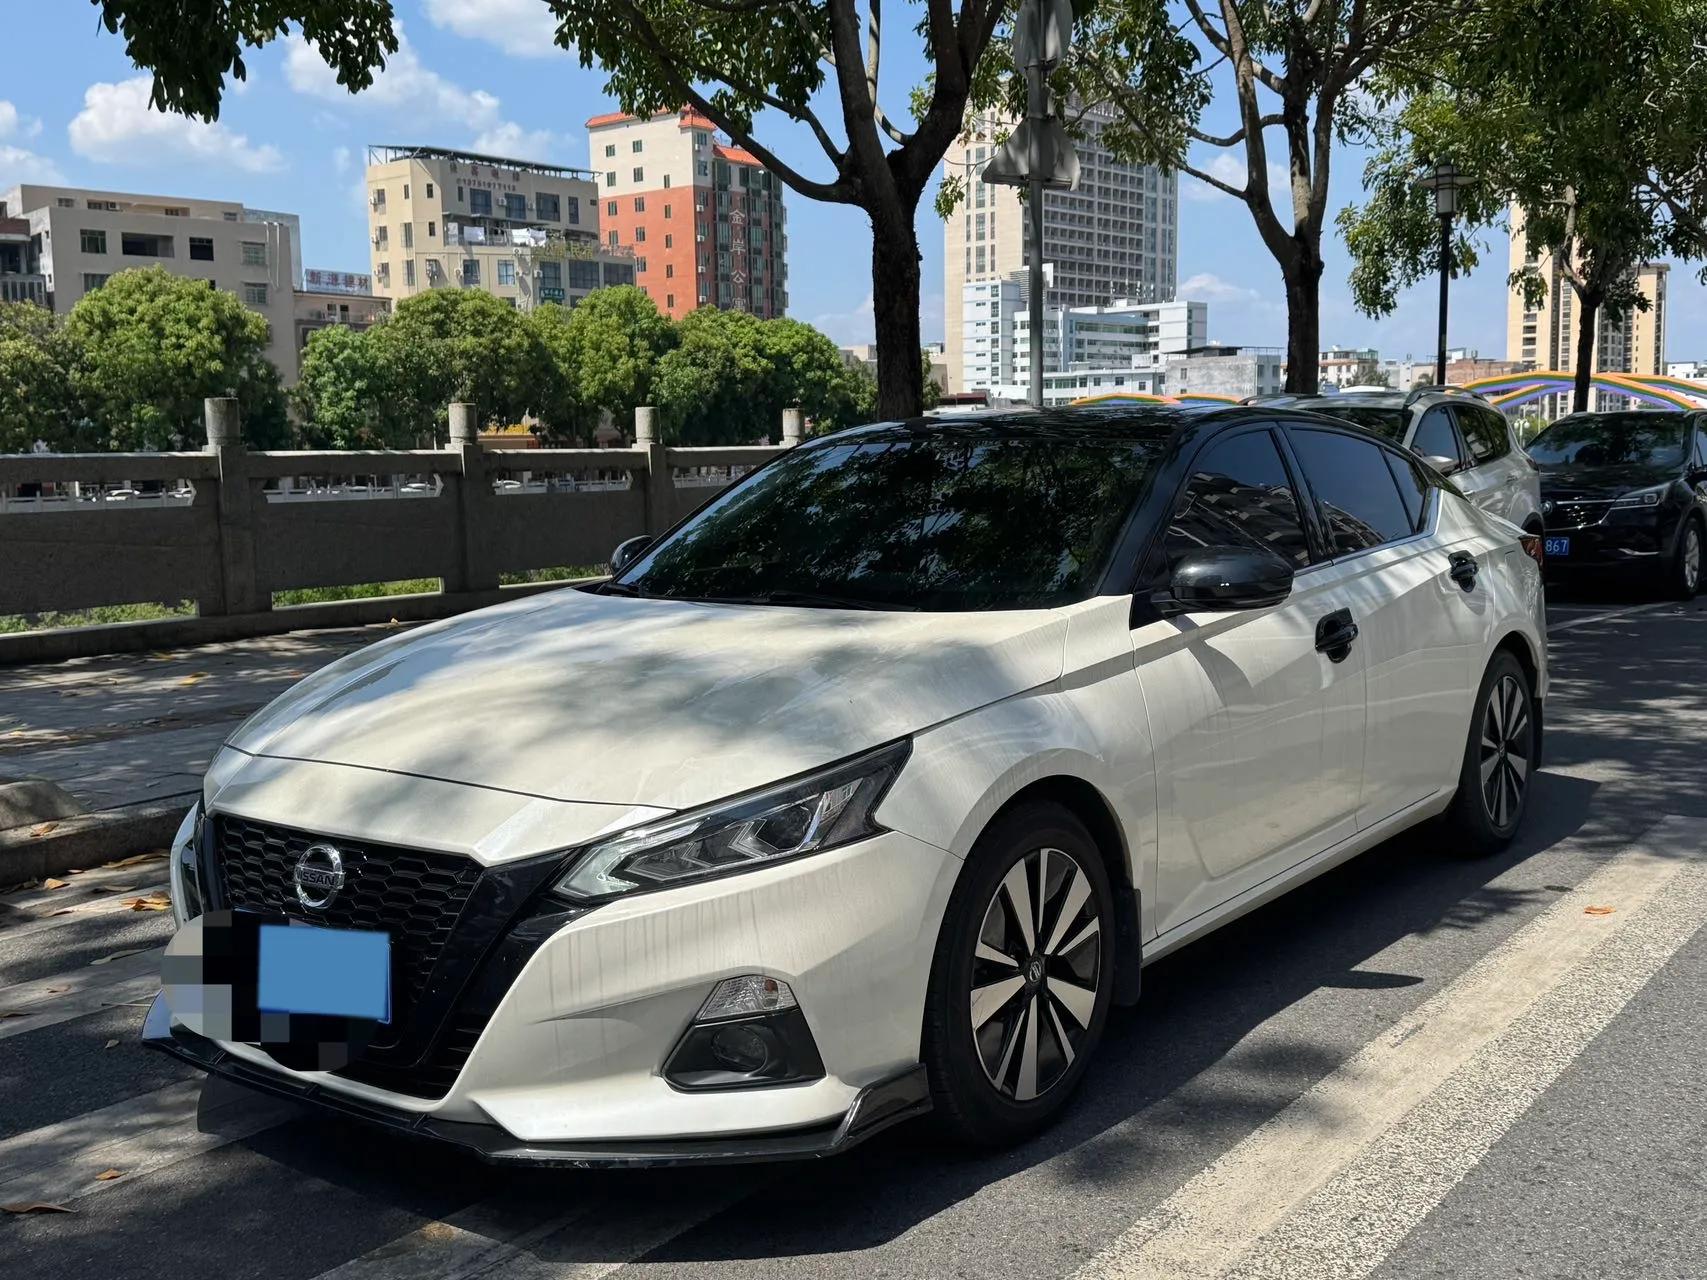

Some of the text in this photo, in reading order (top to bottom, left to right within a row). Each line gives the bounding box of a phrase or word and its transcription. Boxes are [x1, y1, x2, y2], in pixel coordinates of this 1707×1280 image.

[729, 208, 747, 312] 金岸公寓
[296, 864, 335, 886] NISSAN
